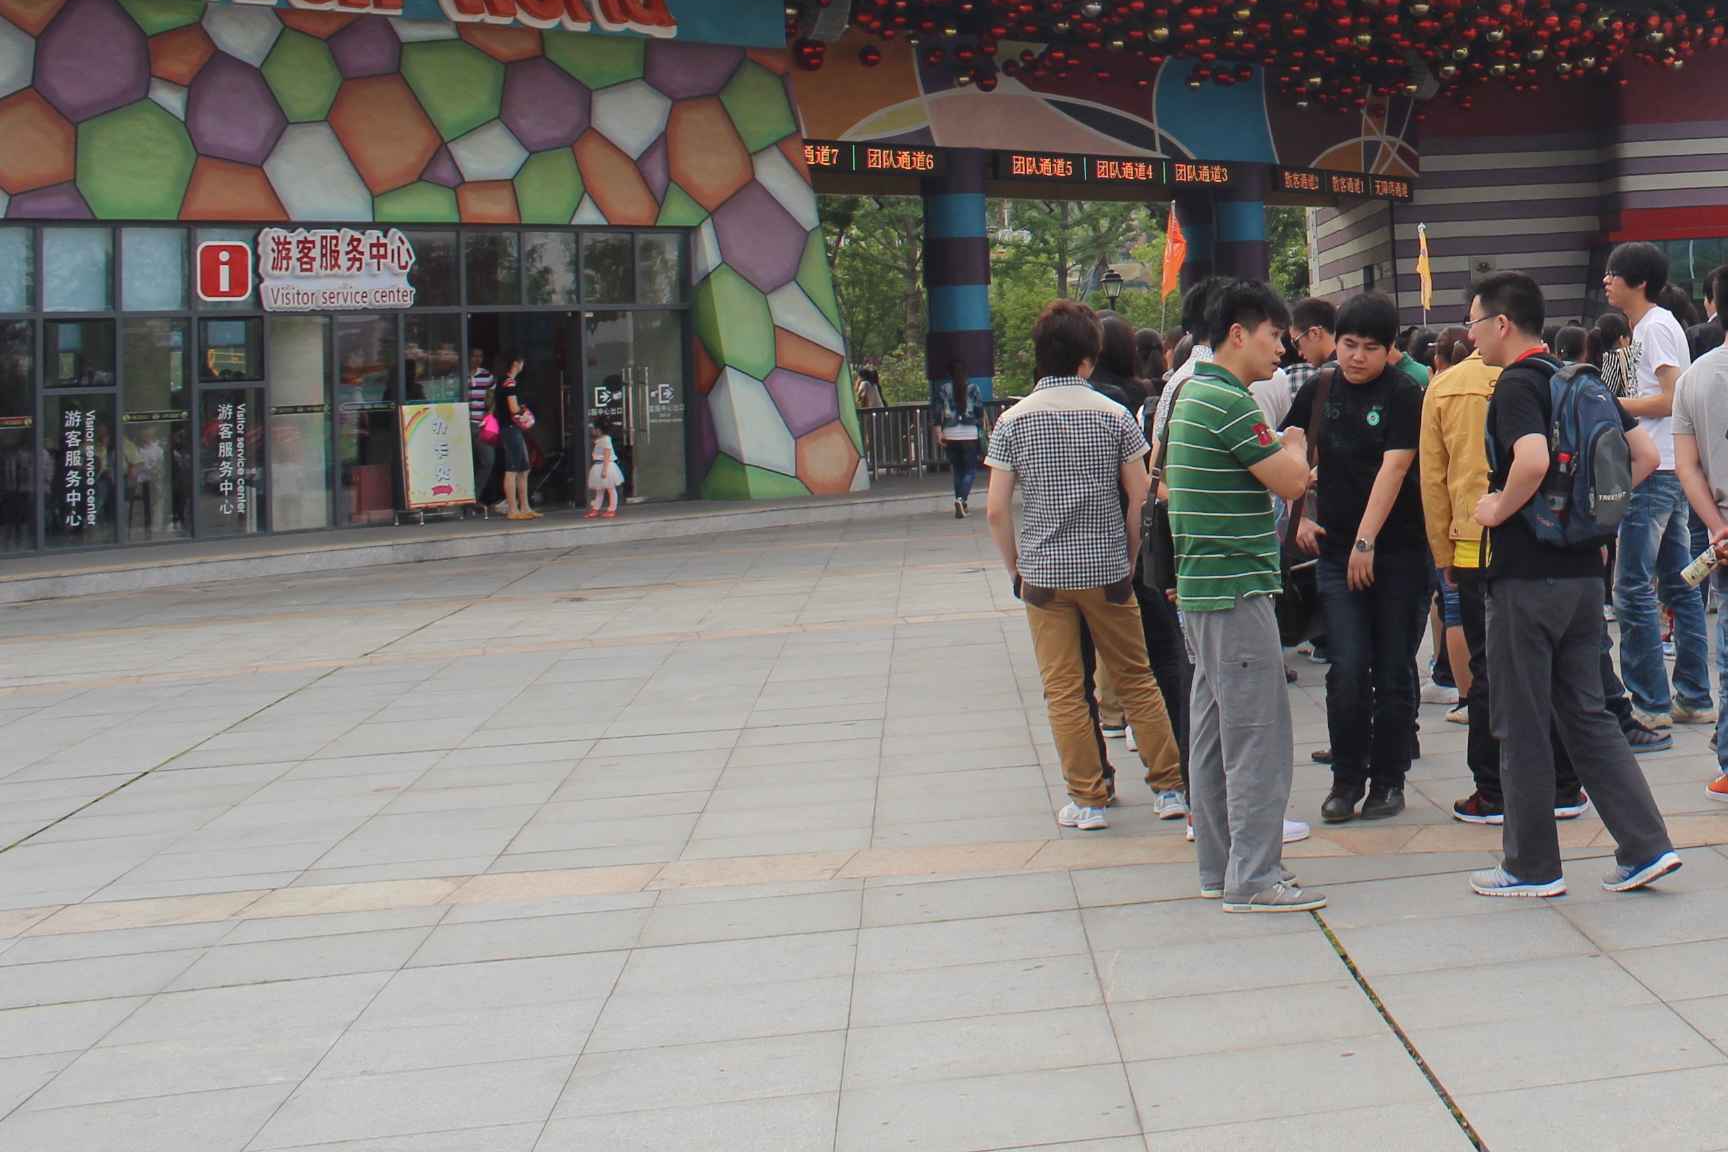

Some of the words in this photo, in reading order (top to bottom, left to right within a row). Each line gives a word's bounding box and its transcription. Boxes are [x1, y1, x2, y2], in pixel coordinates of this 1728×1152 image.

[867, 149, 934, 170] 团队通道6
[1012, 156, 1073, 177] 团队通道5
[1096, 160, 1153, 181] 团队通道4
[1175, 163, 1229, 184] 团队通道3
[271, 235, 413, 273] 游客服务中心
[271, 287, 316, 306] Visitor
[321, 287, 368, 305] service
[372, 288, 414, 304] center
[65, 409, 82, 527] 游客服务中心
[218, 403, 234, 516] 游客服务中心
